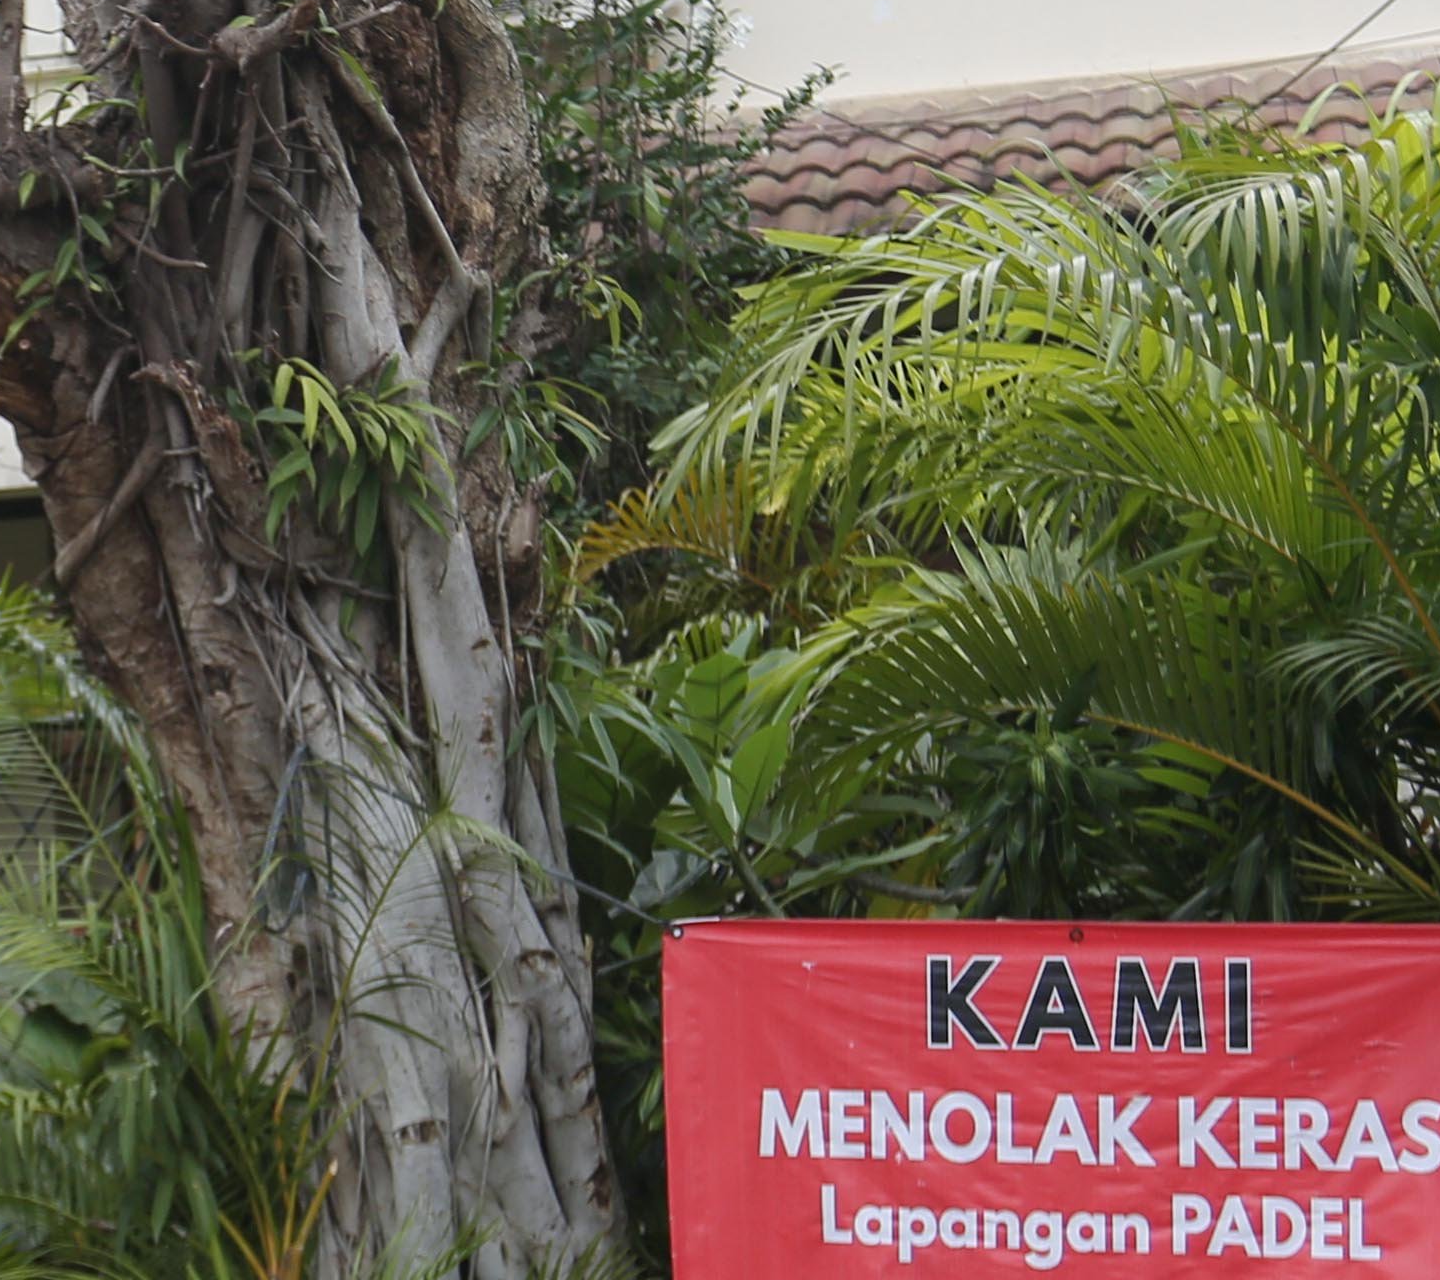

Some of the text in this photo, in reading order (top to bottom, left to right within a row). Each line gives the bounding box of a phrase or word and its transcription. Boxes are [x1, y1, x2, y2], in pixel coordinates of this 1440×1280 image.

[926, 953, 1252, 1054] KAMI
[759, 1089, 1156, 1167] MENOLAK
[822, 1184, 1381, 1270] Lapangan PADEL
